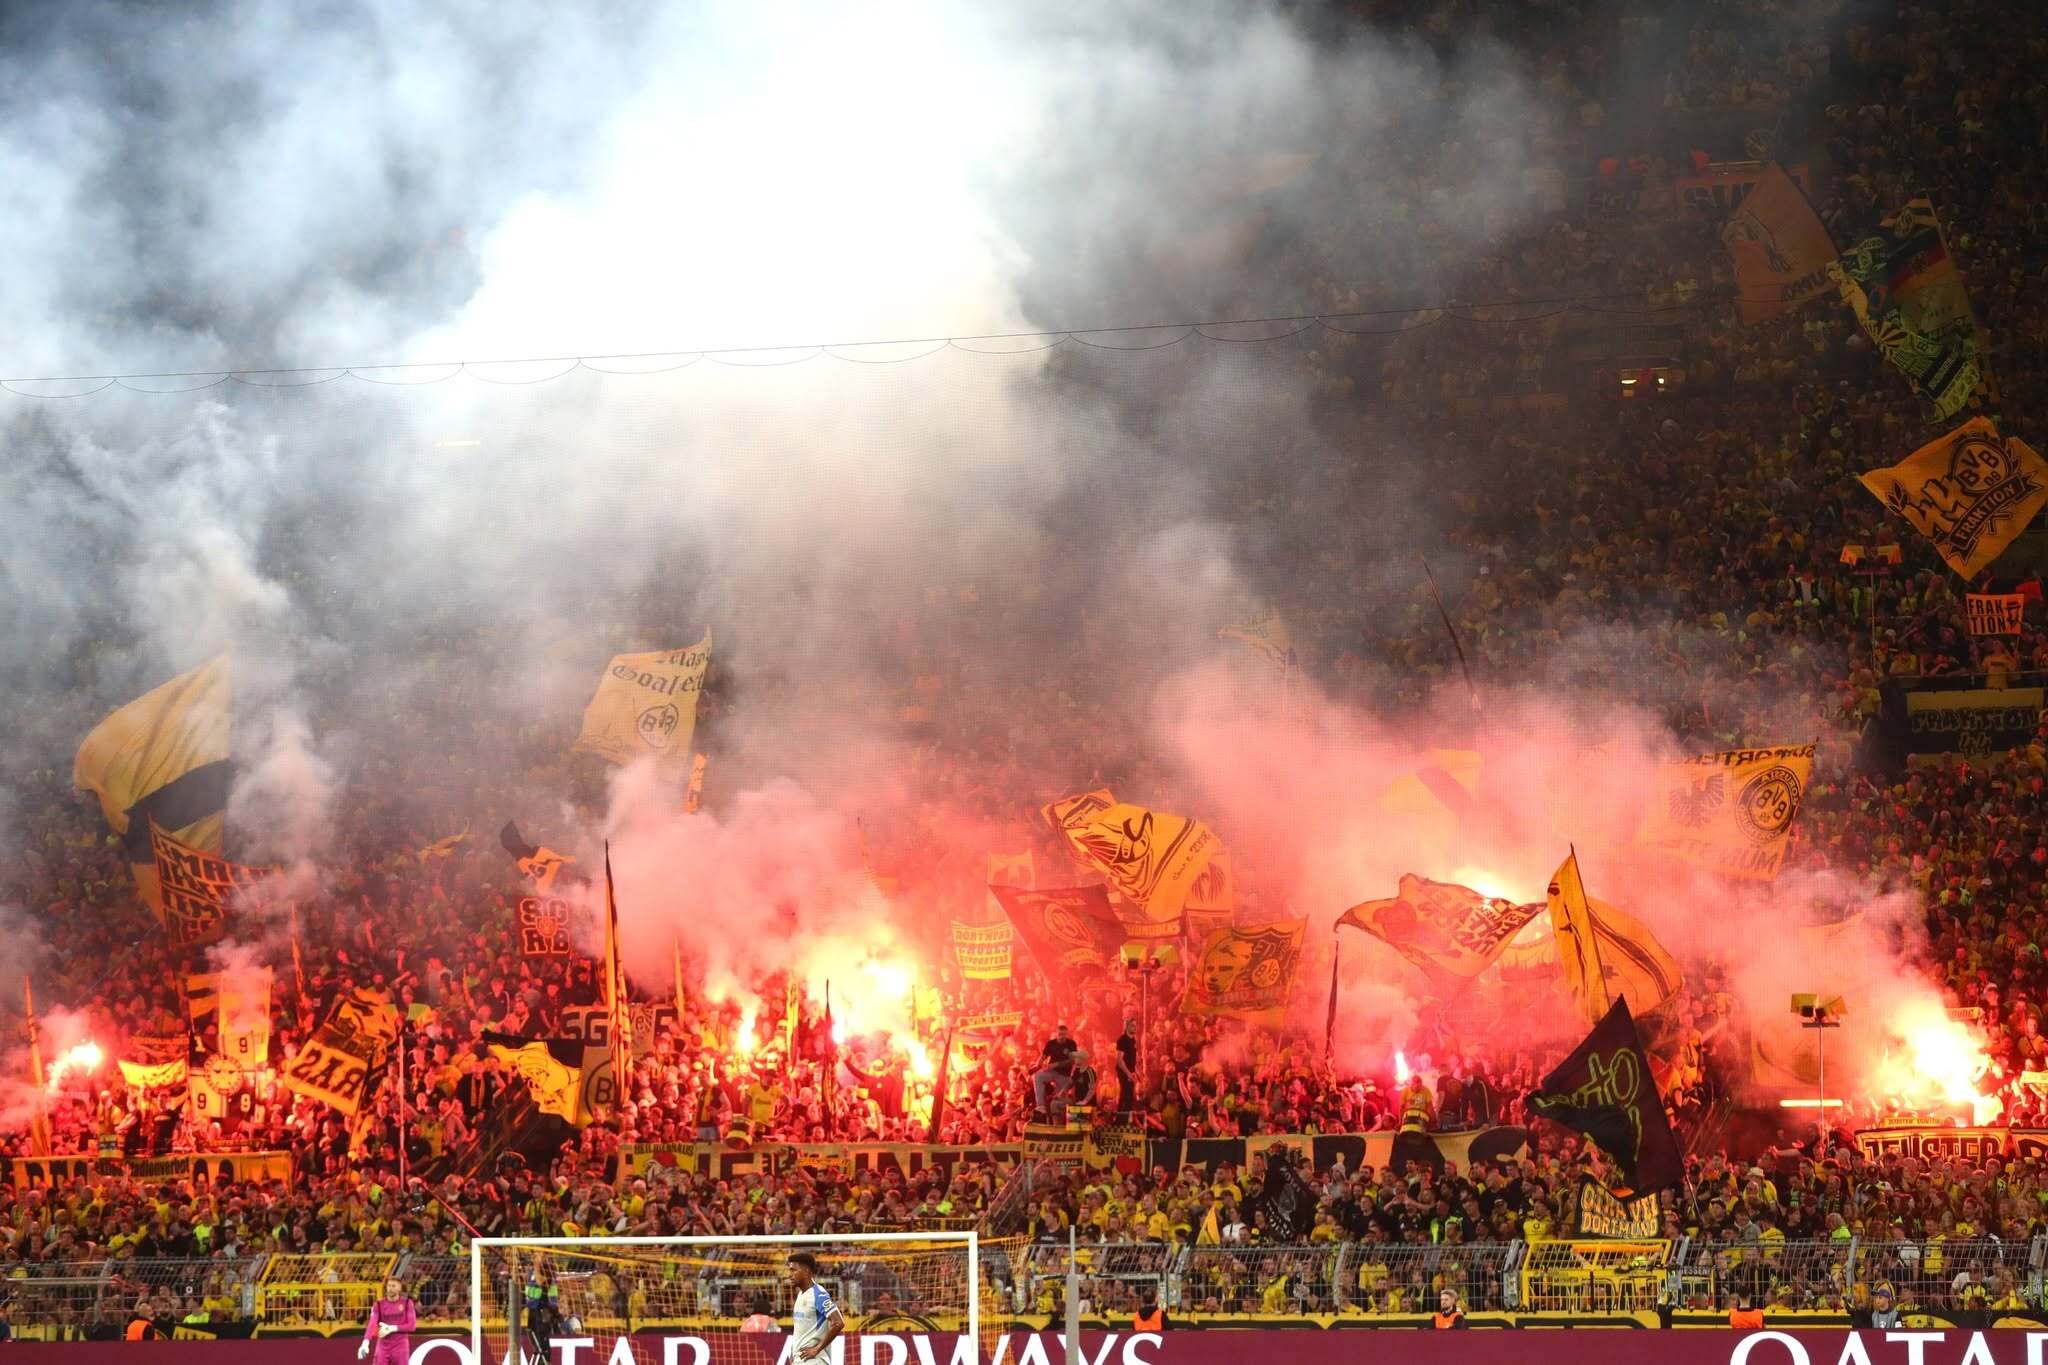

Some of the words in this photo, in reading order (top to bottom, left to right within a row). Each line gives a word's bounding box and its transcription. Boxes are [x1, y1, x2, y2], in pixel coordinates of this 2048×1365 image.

[1958, 449, 2000, 488] BVB
[1957, 482, 2018, 541] FRAKTION
[1967, 598, 2003, 615] FRAK
[1970, 616, 2007, 634] TION
